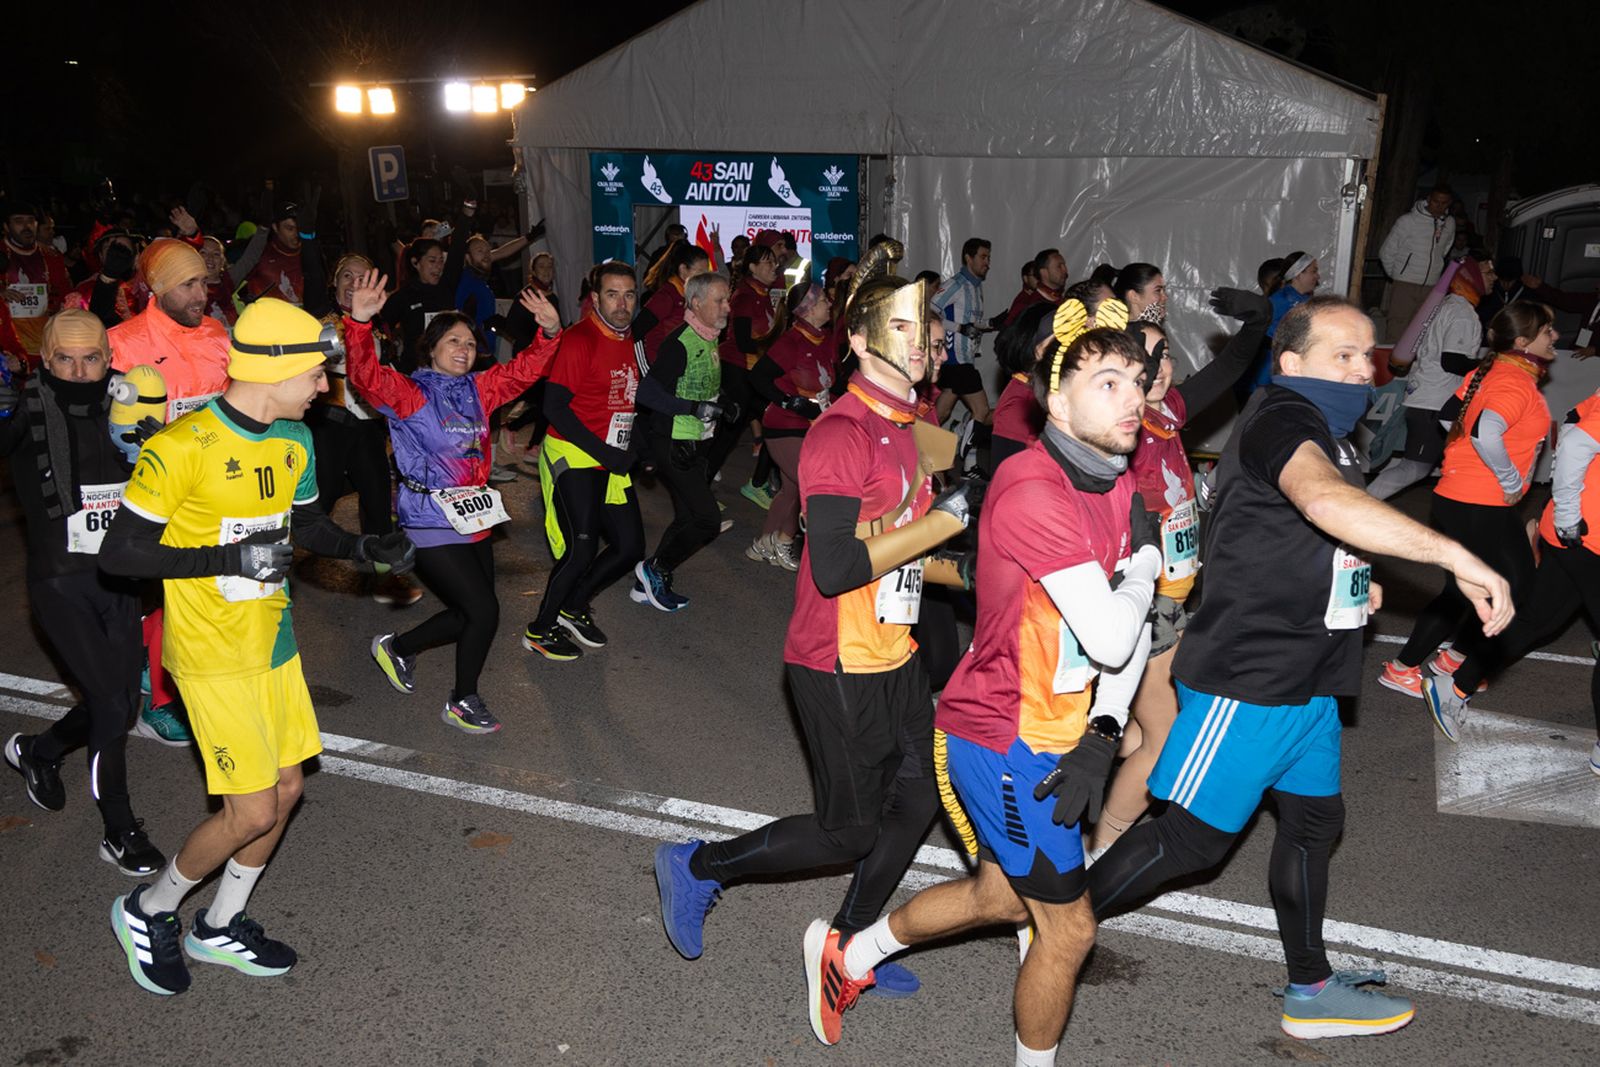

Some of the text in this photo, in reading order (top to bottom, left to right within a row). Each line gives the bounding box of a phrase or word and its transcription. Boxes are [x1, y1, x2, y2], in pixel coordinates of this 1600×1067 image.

[378, 153, 399, 182] P
[690, 160, 754, 181] 43 SAN
[650, 182, 662, 196] 43
[685, 178, 751, 201] ANTÓN
[778, 184, 791, 199] 43
[254, 466, 275, 500] 10
[86, 493, 111, 501] NOCHE
[453, 494, 493, 516] 5600
